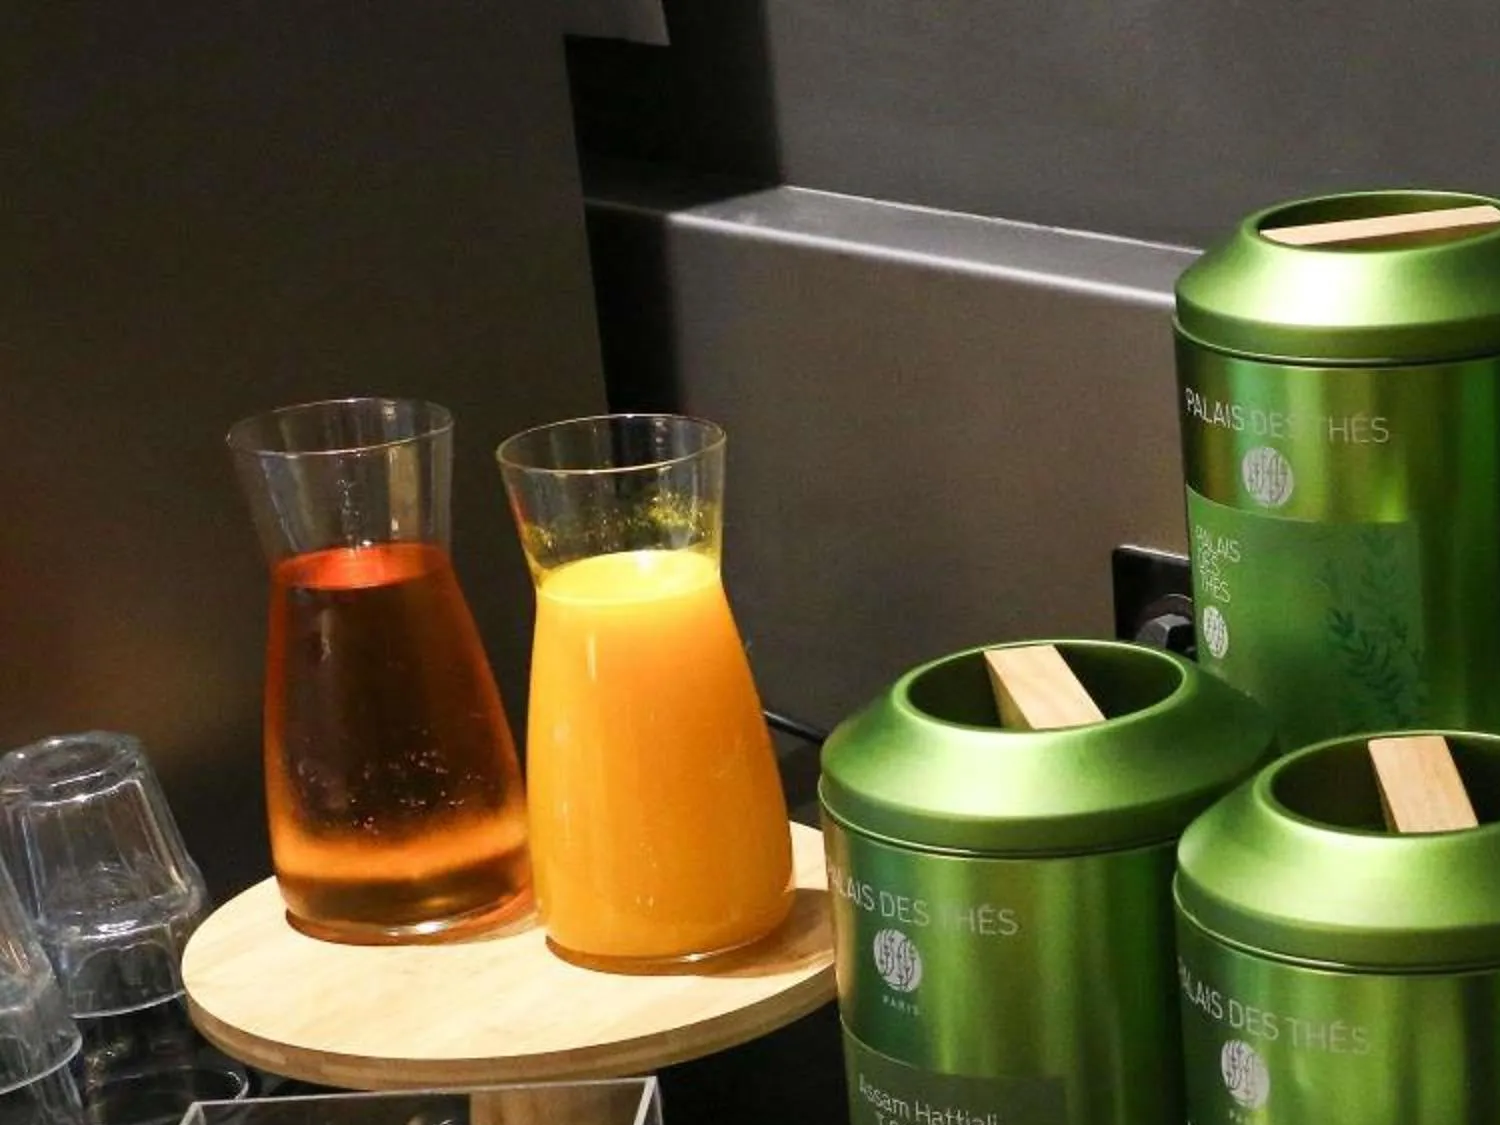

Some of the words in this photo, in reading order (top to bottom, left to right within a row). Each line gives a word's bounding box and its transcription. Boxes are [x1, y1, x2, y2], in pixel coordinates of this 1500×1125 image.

[1184, 387, 1246, 432] PALAIS
[1322, 411, 1390, 444] HÉS
[878, 890, 930, 927] DES
[1228, 998, 1280, 1042] DES
[1285, 1016, 1371, 1056] THÉS
[858, 1072, 911, 1121] Assam
